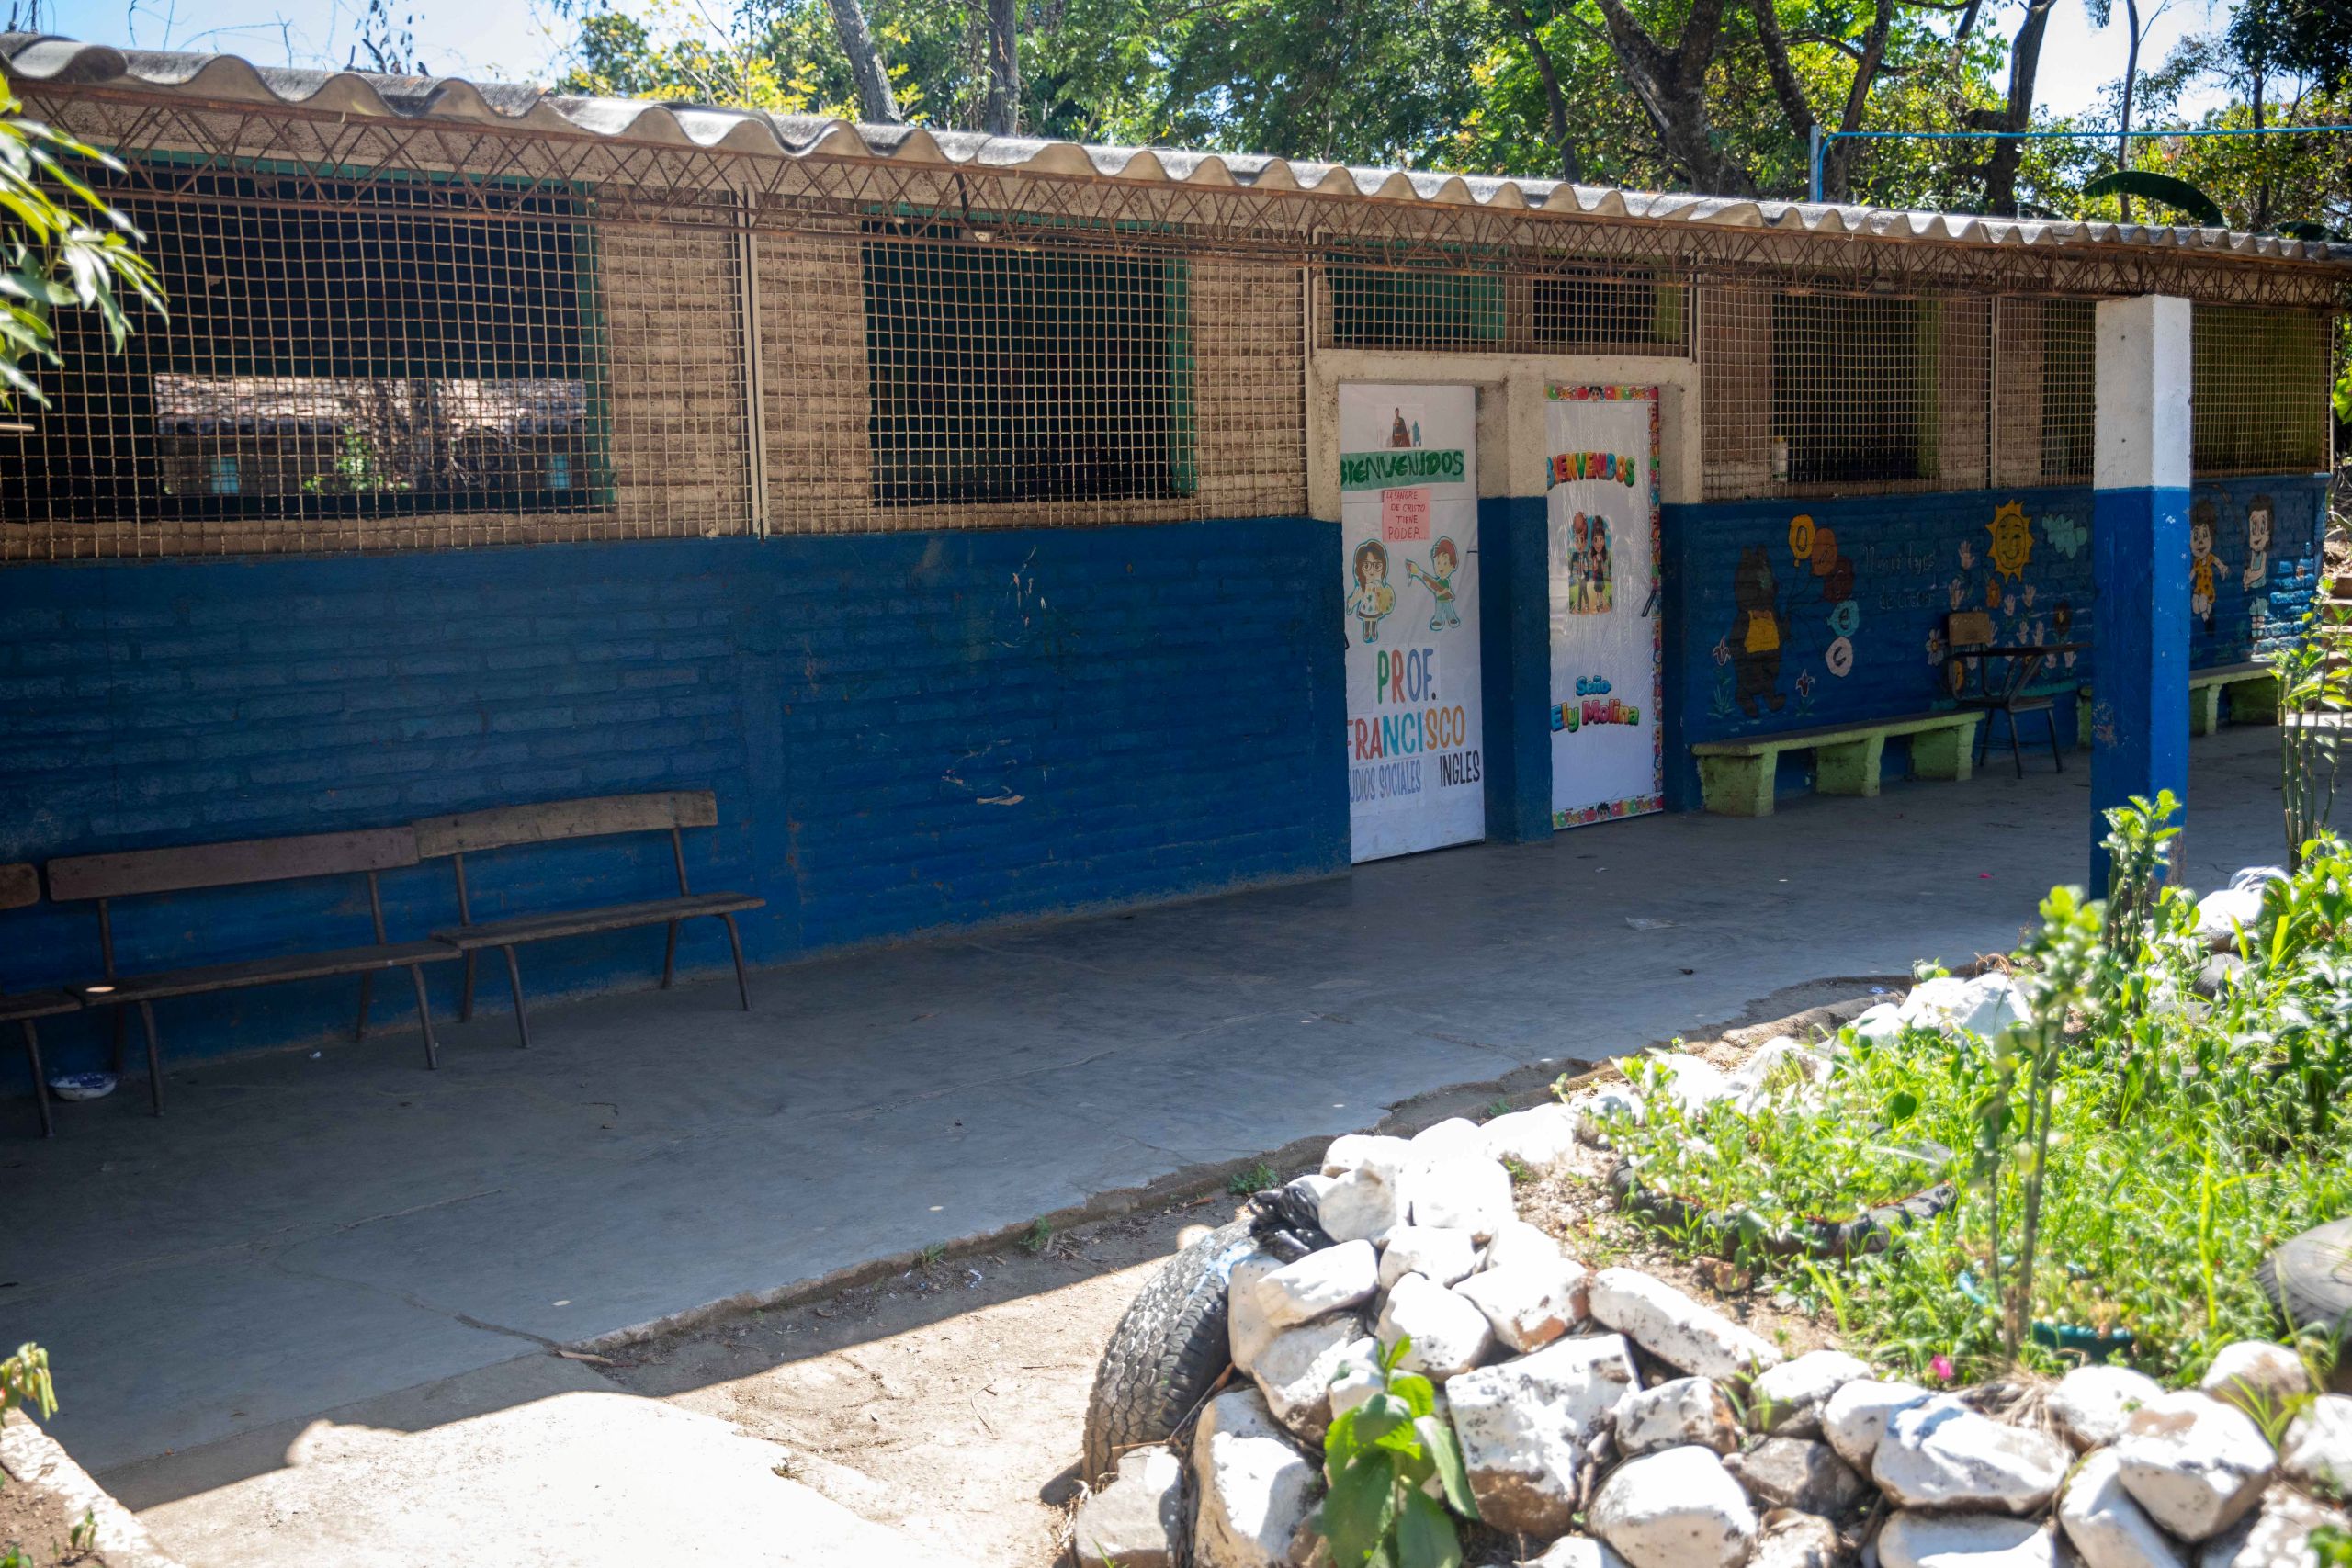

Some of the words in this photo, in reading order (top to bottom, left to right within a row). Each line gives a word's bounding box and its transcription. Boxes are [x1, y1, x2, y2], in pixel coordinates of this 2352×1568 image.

[1390, 503, 1400, 512] DE
[1402, 503, 1426, 513] CRISTO
[1394, 491, 1419, 500] SANGRE
[1396, 514, 1419, 524] TIENE
[1377, 648, 1436, 705] PROF.
[1576, 674, 1612, 696] Seño
[1550, 701, 1580, 733] Ely
[1581, 698, 1640, 726] Molina
[1379, 759, 1421, 799] SOCIALES
[1440, 750, 1481, 788] INGLES
